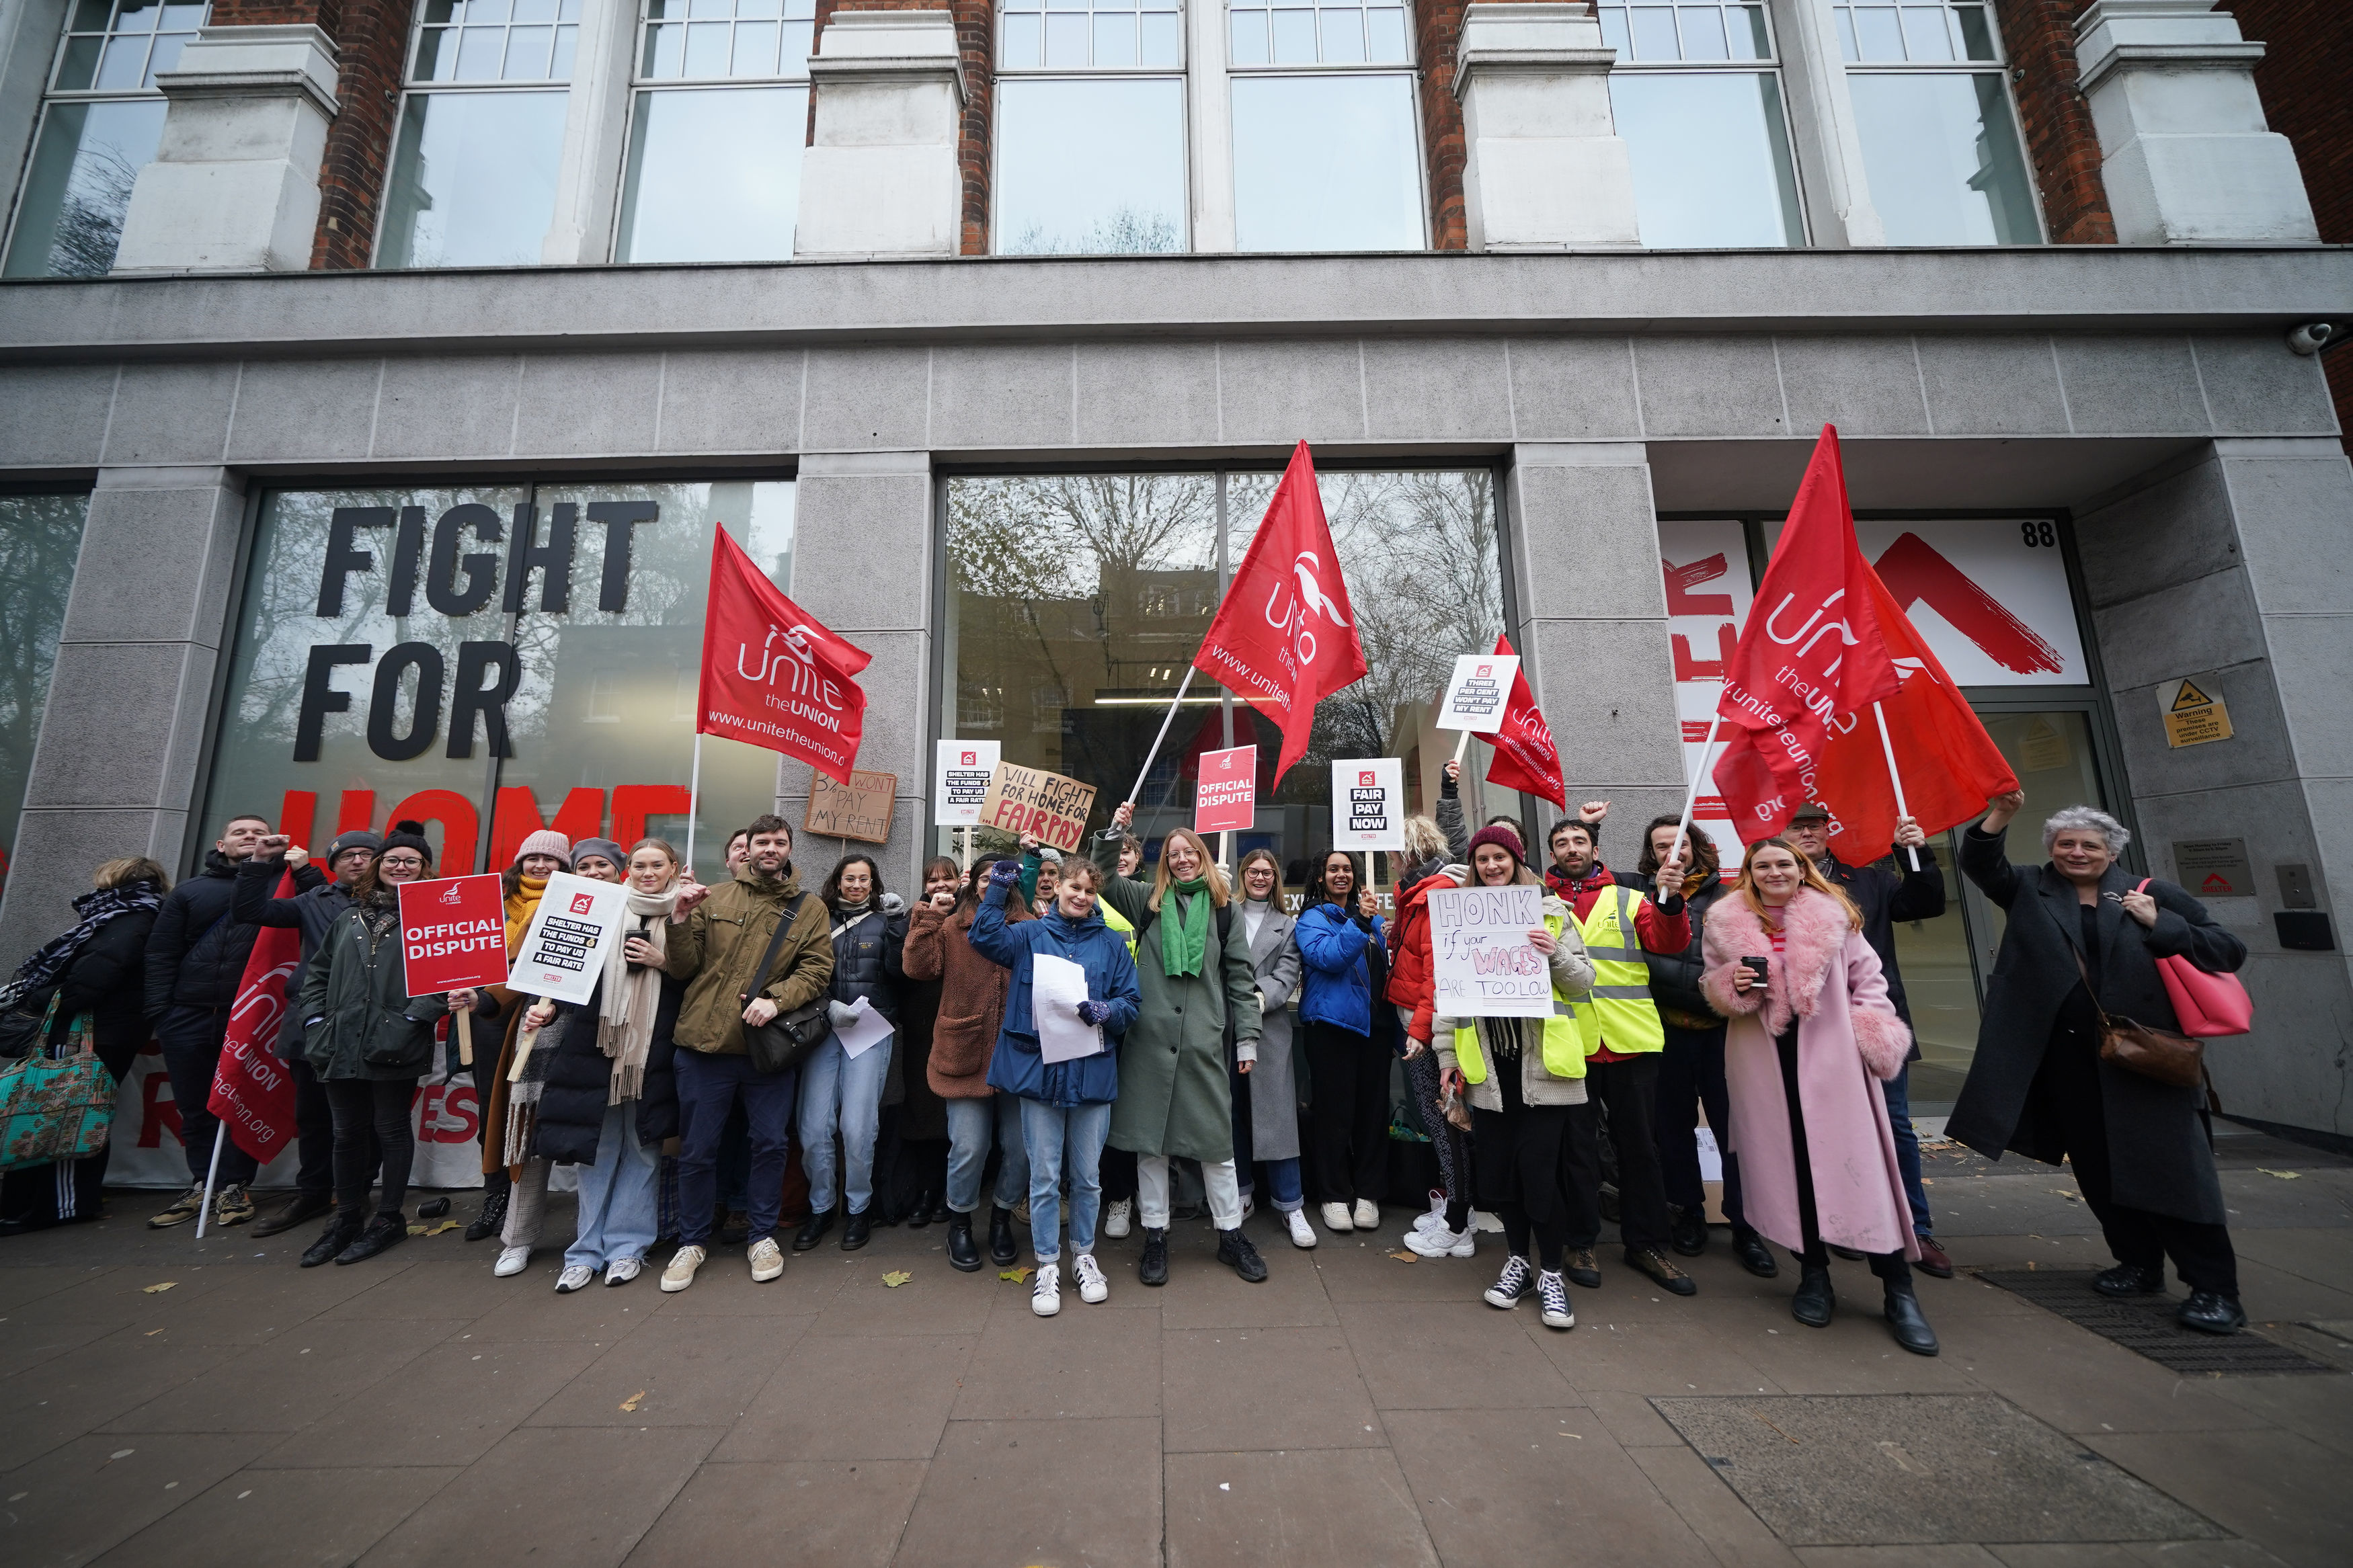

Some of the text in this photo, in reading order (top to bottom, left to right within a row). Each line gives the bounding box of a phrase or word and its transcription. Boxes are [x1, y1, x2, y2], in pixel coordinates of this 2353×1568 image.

[2022, 522, 2055, 548] 88
[316, 501, 659, 617] FIGHT
[293, 641, 522, 761] FOR
[765, 694, 840, 733] theUNION
[2176, 708, 2213, 719] Warning
[2176, 723, 2206, 734] premises
[2180, 733, 2221, 743] surveillance
[854, 775, 894, 792] WONT
[1001, 783, 1025, 801] FOR
[1004, 766, 1094, 807] WILL FIGHT
[1199, 778, 1252, 794] OFFICIAL
[836, 790, 867, 812] PAY
[1199, 791, 1252, 808] DISPUTE
[1353, 789, 1382, 800] FAIR
[1356, 803, 1381, 815] PAY
[813, 809, 887, 835] MY RENT
[1352, 818, 1385, 829] NOW
[2201, 885, 2232, 893] SHELTER
[440, 895, 461, 903] unite
[1437, 891, 1536, 927] HONK
[406, 918, 502, 941] OFFICIAL
[547, 917, 600, 935] SHELTER HAS
[542, 929, 586, 944] THE FUNDS
[1444, 930, 1488, 960] if your
[409, 934, 502, 960] DISPUTE
[545, 942, 584, 957] TO PAY US
[543, 956, 561, 966] FAIR
[561, 960, 584, 971] RATE
[1471, 943, 1542, 976] WAGES
[1439, 978, 1550, 998] ARE TOO LOW
[223, 1030, 282, 1092] heUNION
